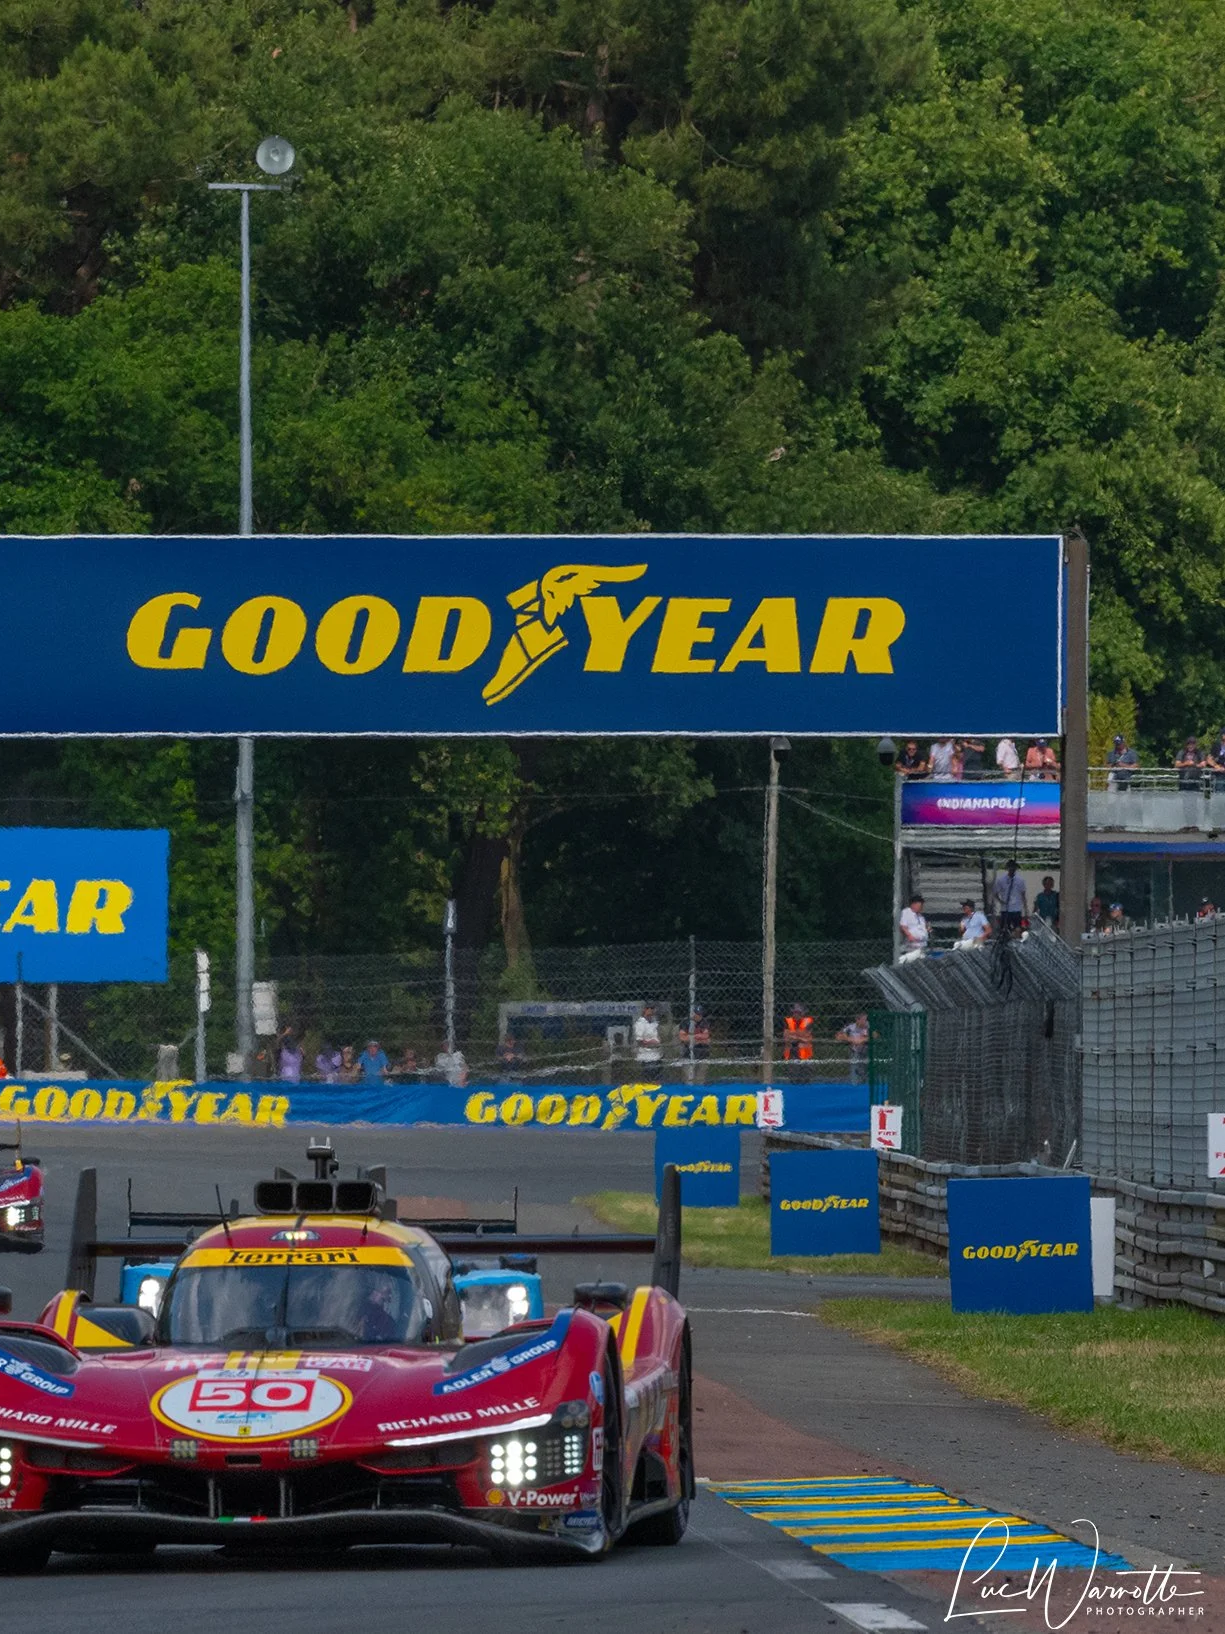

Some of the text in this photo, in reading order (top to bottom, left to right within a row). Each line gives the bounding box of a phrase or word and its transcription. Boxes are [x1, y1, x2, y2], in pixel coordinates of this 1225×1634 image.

[125, 590, 906, 677] GOODYEAR
[464, 1088, 758, 1127] GOODYEAR
[780, 1196, 869, 1211] GOODYEAR
[225, 1247, 361, 1264] Ferrari
[962, 1242, 1079, 1260] GOODYEAR
[442, 1339, 558, 1394] ADLER GROUP
[19, 1371, 70, 1395] GROUP
[196, 1381, 308, 1408] 50
[54, 1416, 118, 1435] MILLE
[376, 1396, 541, 1433] RICHARD MILLE
[508, 1490, 576, 1507] V-Power
